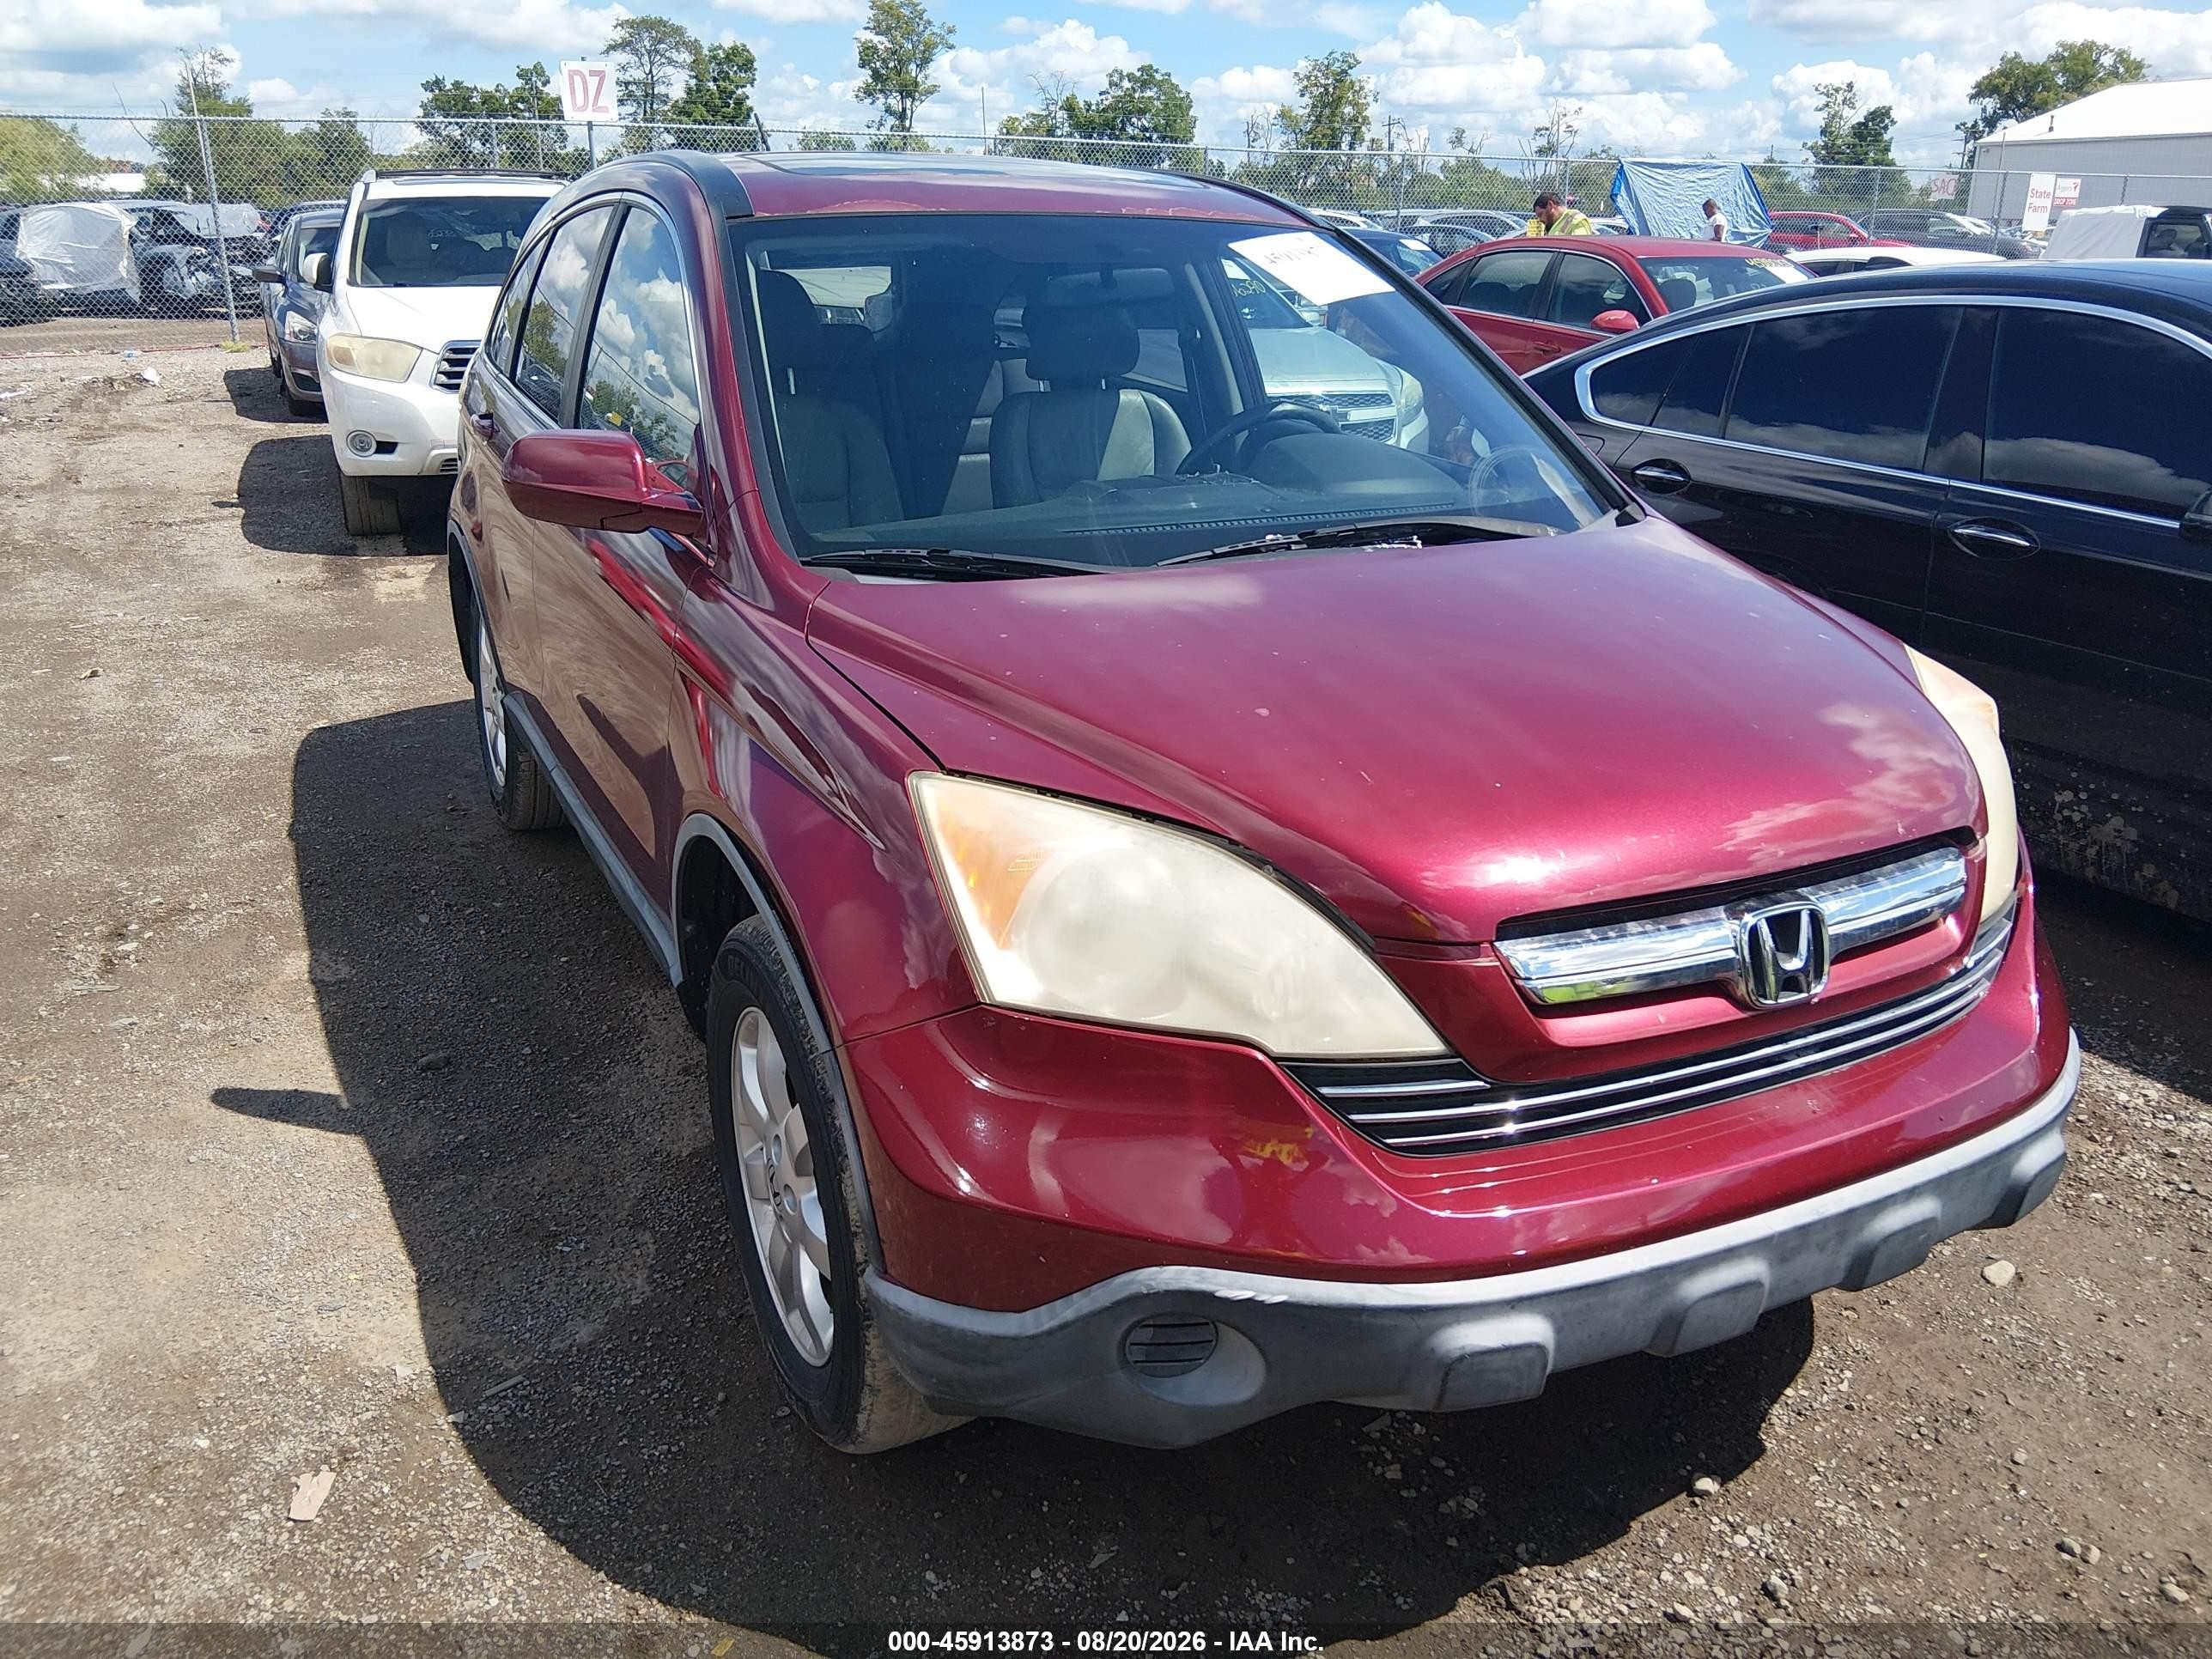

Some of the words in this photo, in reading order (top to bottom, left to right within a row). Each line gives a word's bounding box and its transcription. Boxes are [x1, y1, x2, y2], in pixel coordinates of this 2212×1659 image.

[568, 70, 609, 112] DZ
[2030, 188, 2051, 198] State
[2028, 203, 2048, 213] Farm
